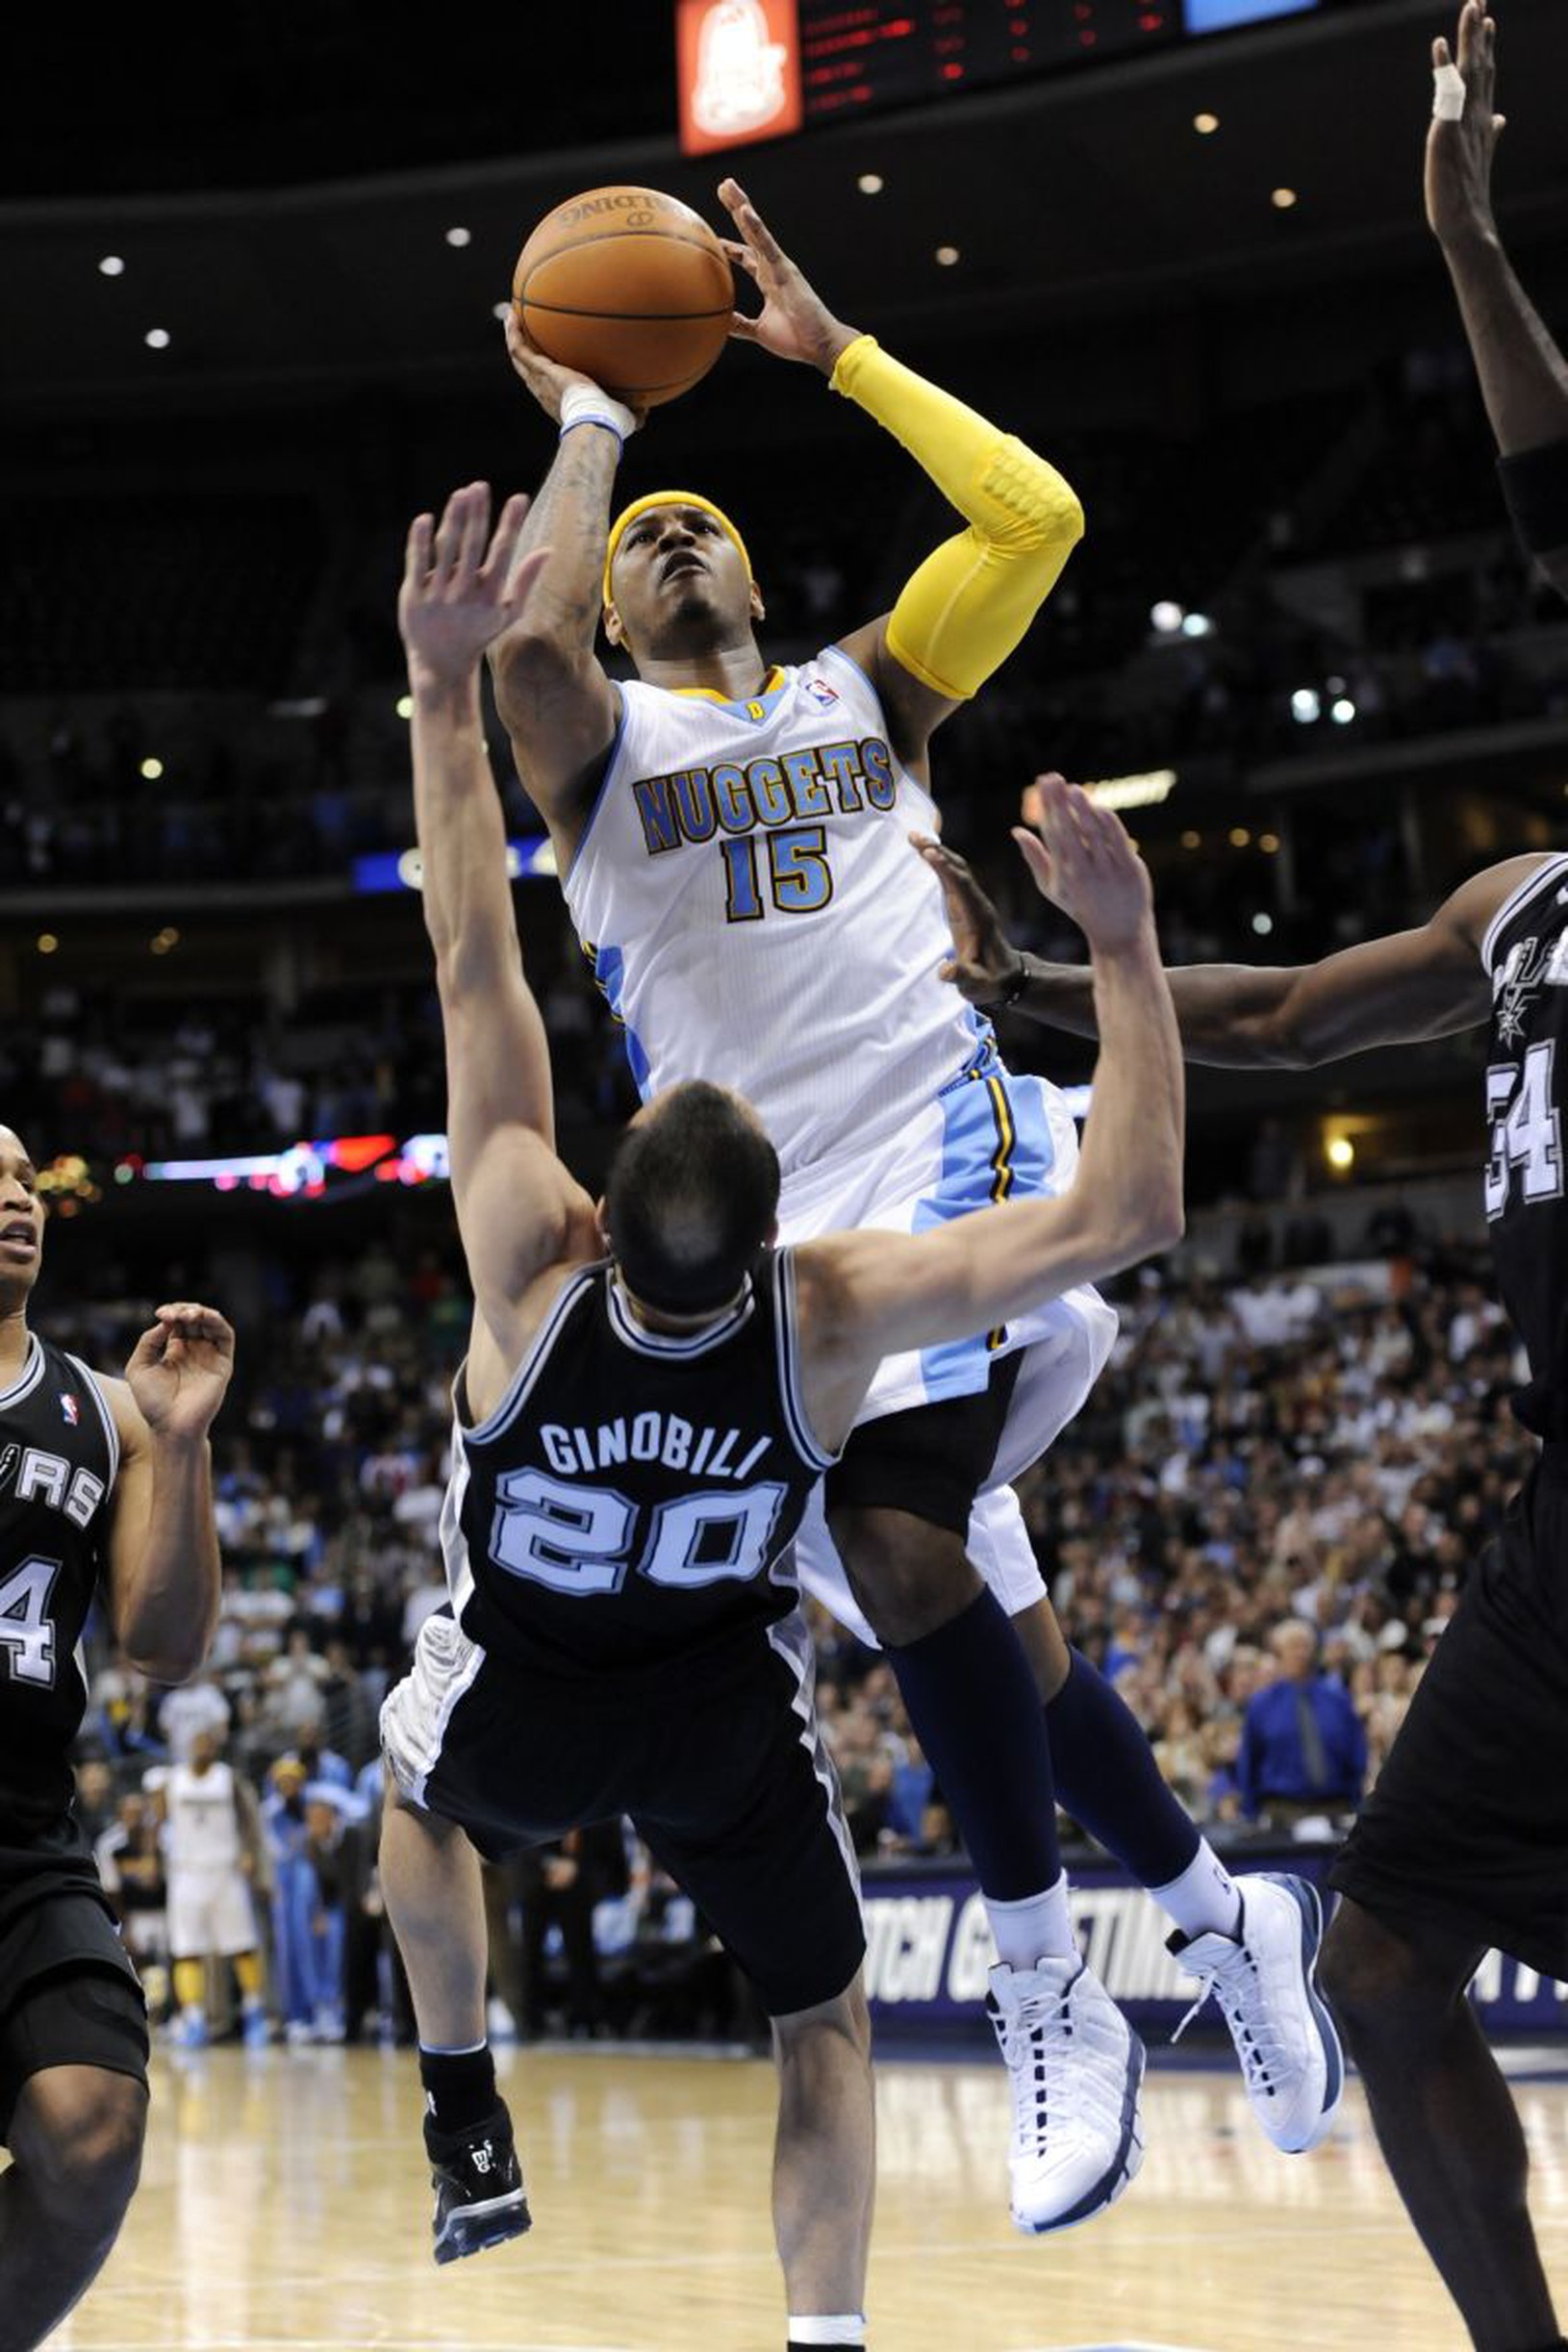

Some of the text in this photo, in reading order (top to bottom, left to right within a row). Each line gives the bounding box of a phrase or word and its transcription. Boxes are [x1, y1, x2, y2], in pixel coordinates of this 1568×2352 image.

[632, 737, 896, 856] NUGGETS
[720, 824, 833, 923] 15
[539, 1410, 772, 1479] GINOBILI
[488, 1466, 789, 1597] 20
